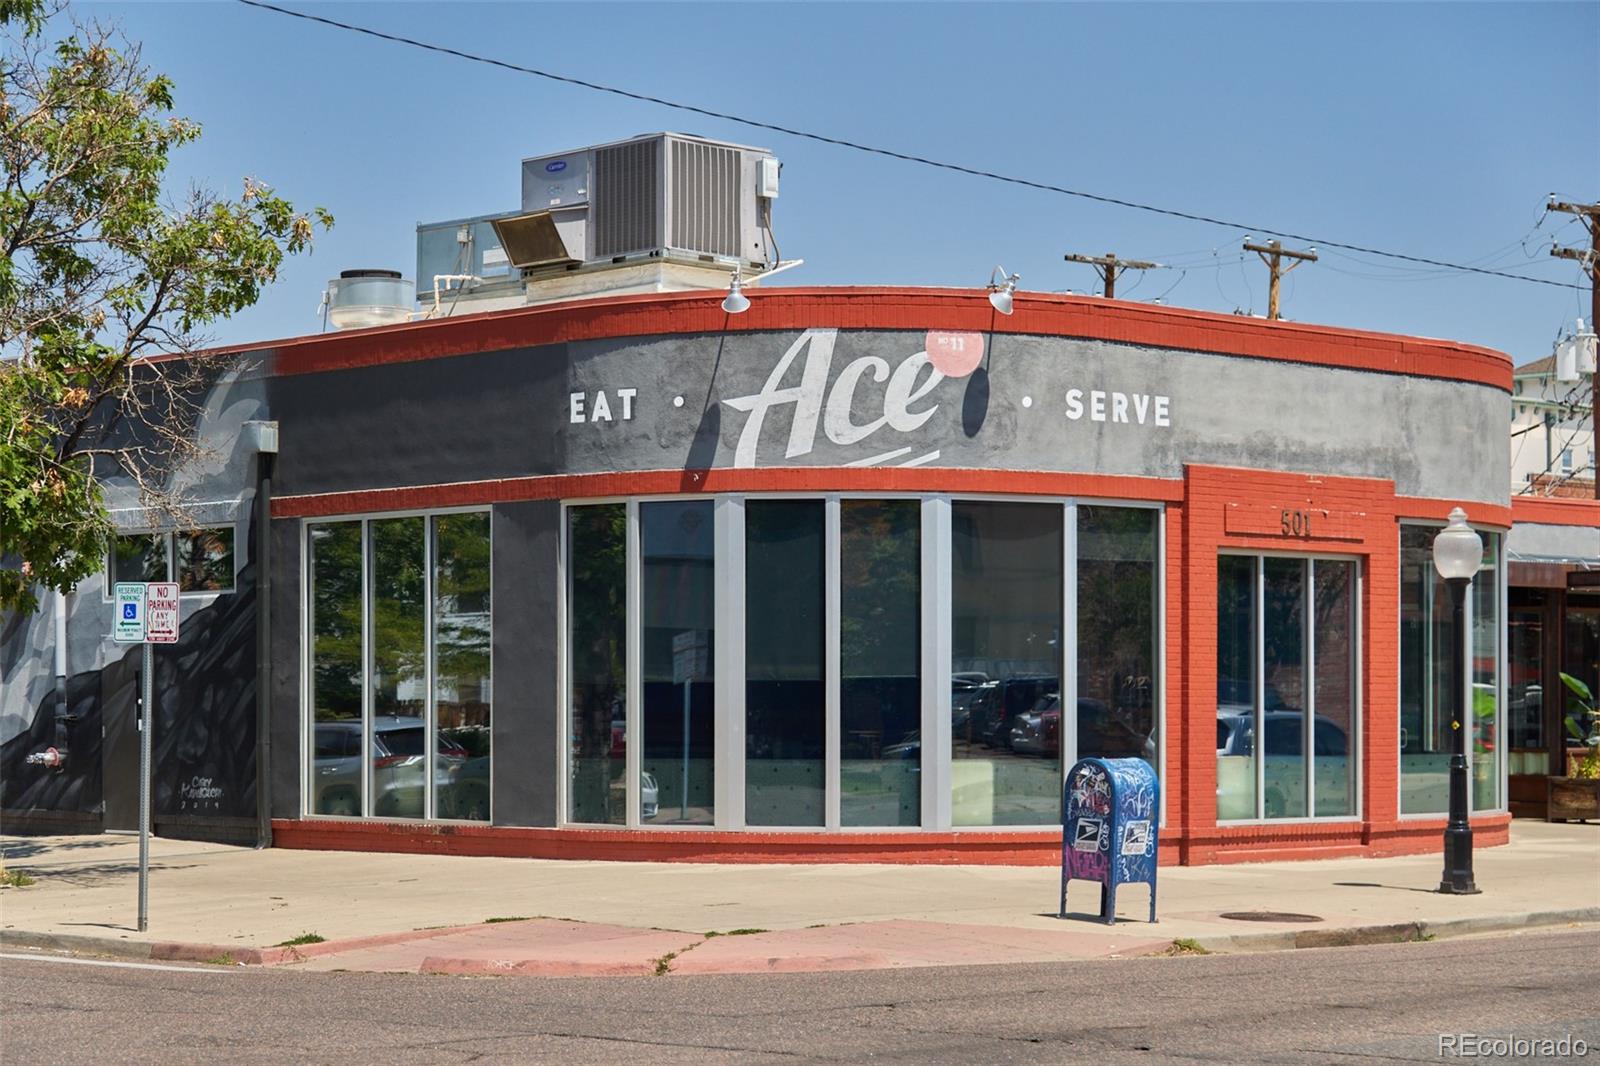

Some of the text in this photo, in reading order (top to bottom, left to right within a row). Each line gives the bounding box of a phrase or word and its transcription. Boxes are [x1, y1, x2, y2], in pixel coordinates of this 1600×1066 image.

[950, 336, 964, 351] 11
[570, 328, 1170, 468] EAT Ace SERVE
[1281, 509, 1310, 537] 501
[157, 587, 169, 598] NO
[149, 600, 177, 611] PARKING
[156, 612, 169, 620] ANY
